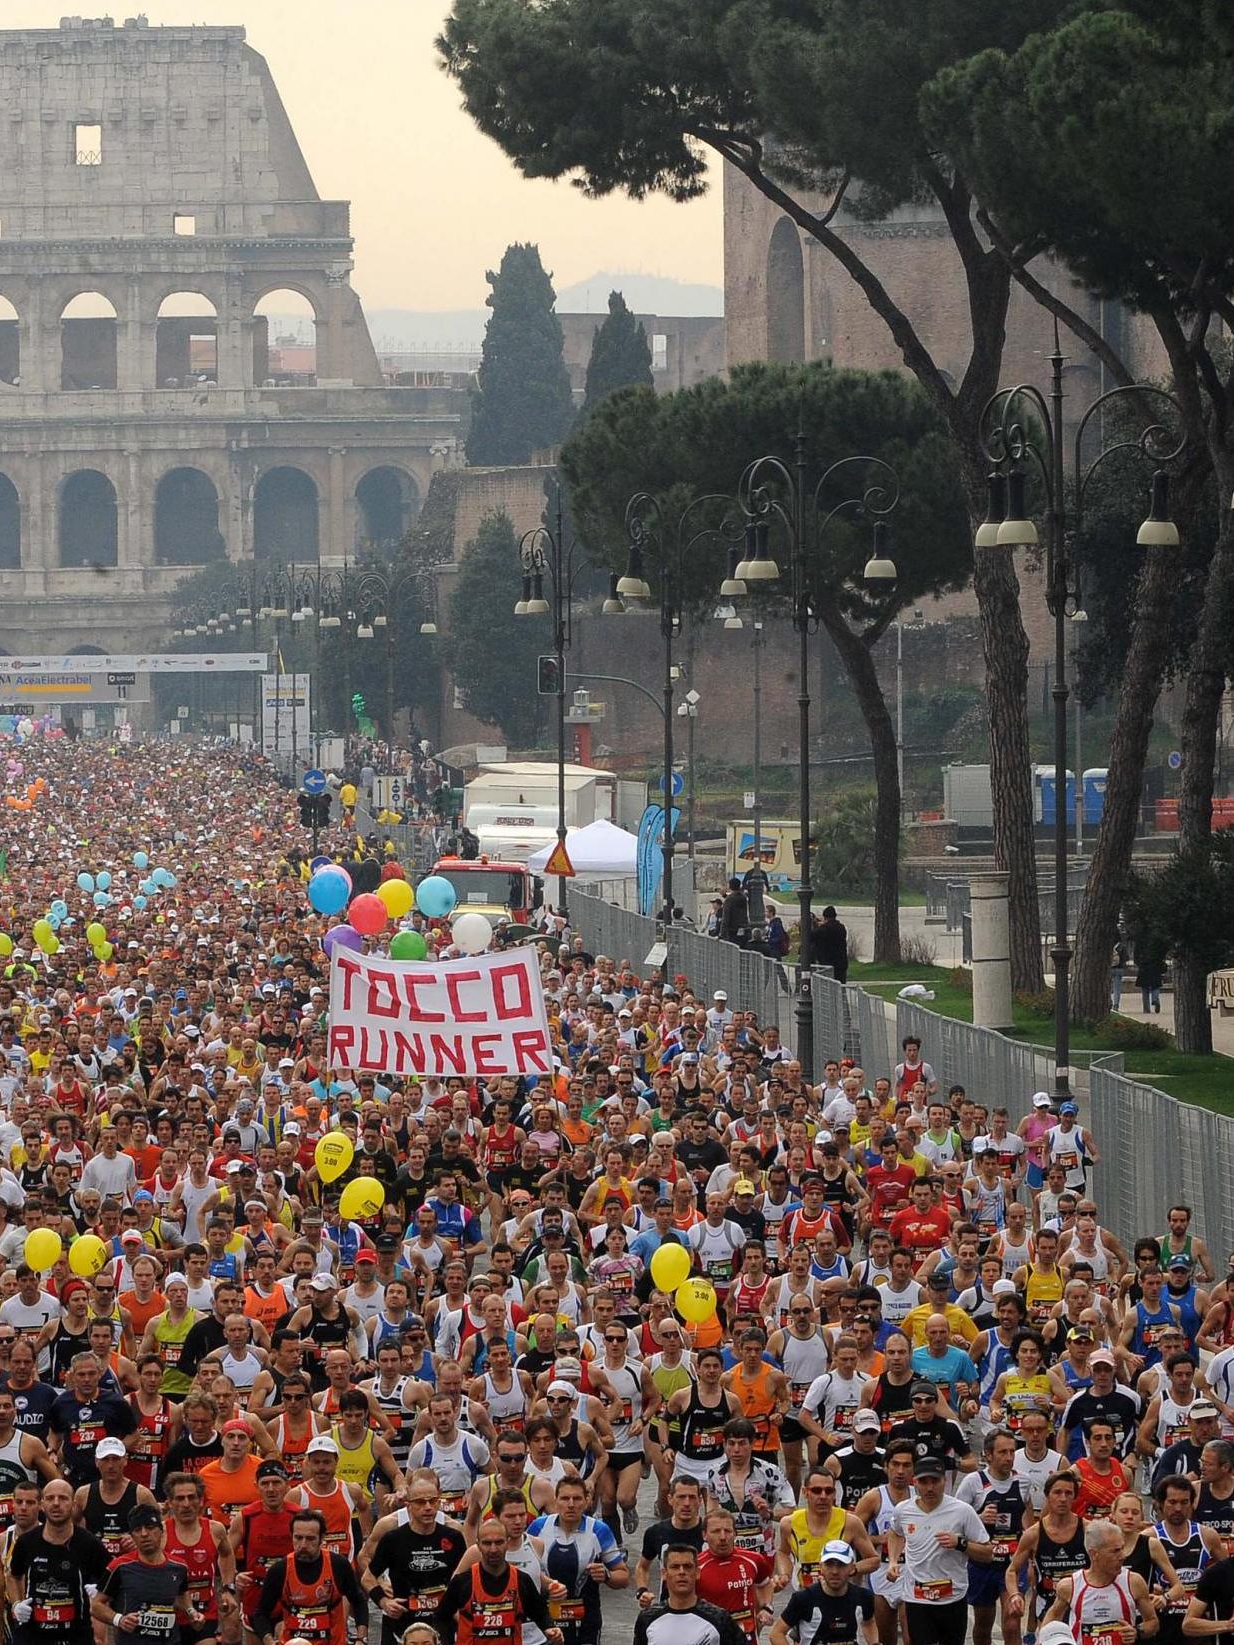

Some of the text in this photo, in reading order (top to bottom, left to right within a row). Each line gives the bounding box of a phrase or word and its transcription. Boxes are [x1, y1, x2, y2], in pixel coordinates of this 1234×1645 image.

[16, 675, 92, 686] AceaElectrabel
[337, 957, 533, 1023] TOCCO
[329, 1025, 549, 1074] RUNNER
[695, 1290, 709, 1300] 3:00
[79, 1431, 96, 1441] 232
[46, 1608, 60, 1621] 94
[140, 1614, 169, 1628] 12568
[298, 1617, 317, 1629] 229
[483, 1615, 503, 1627] 228
